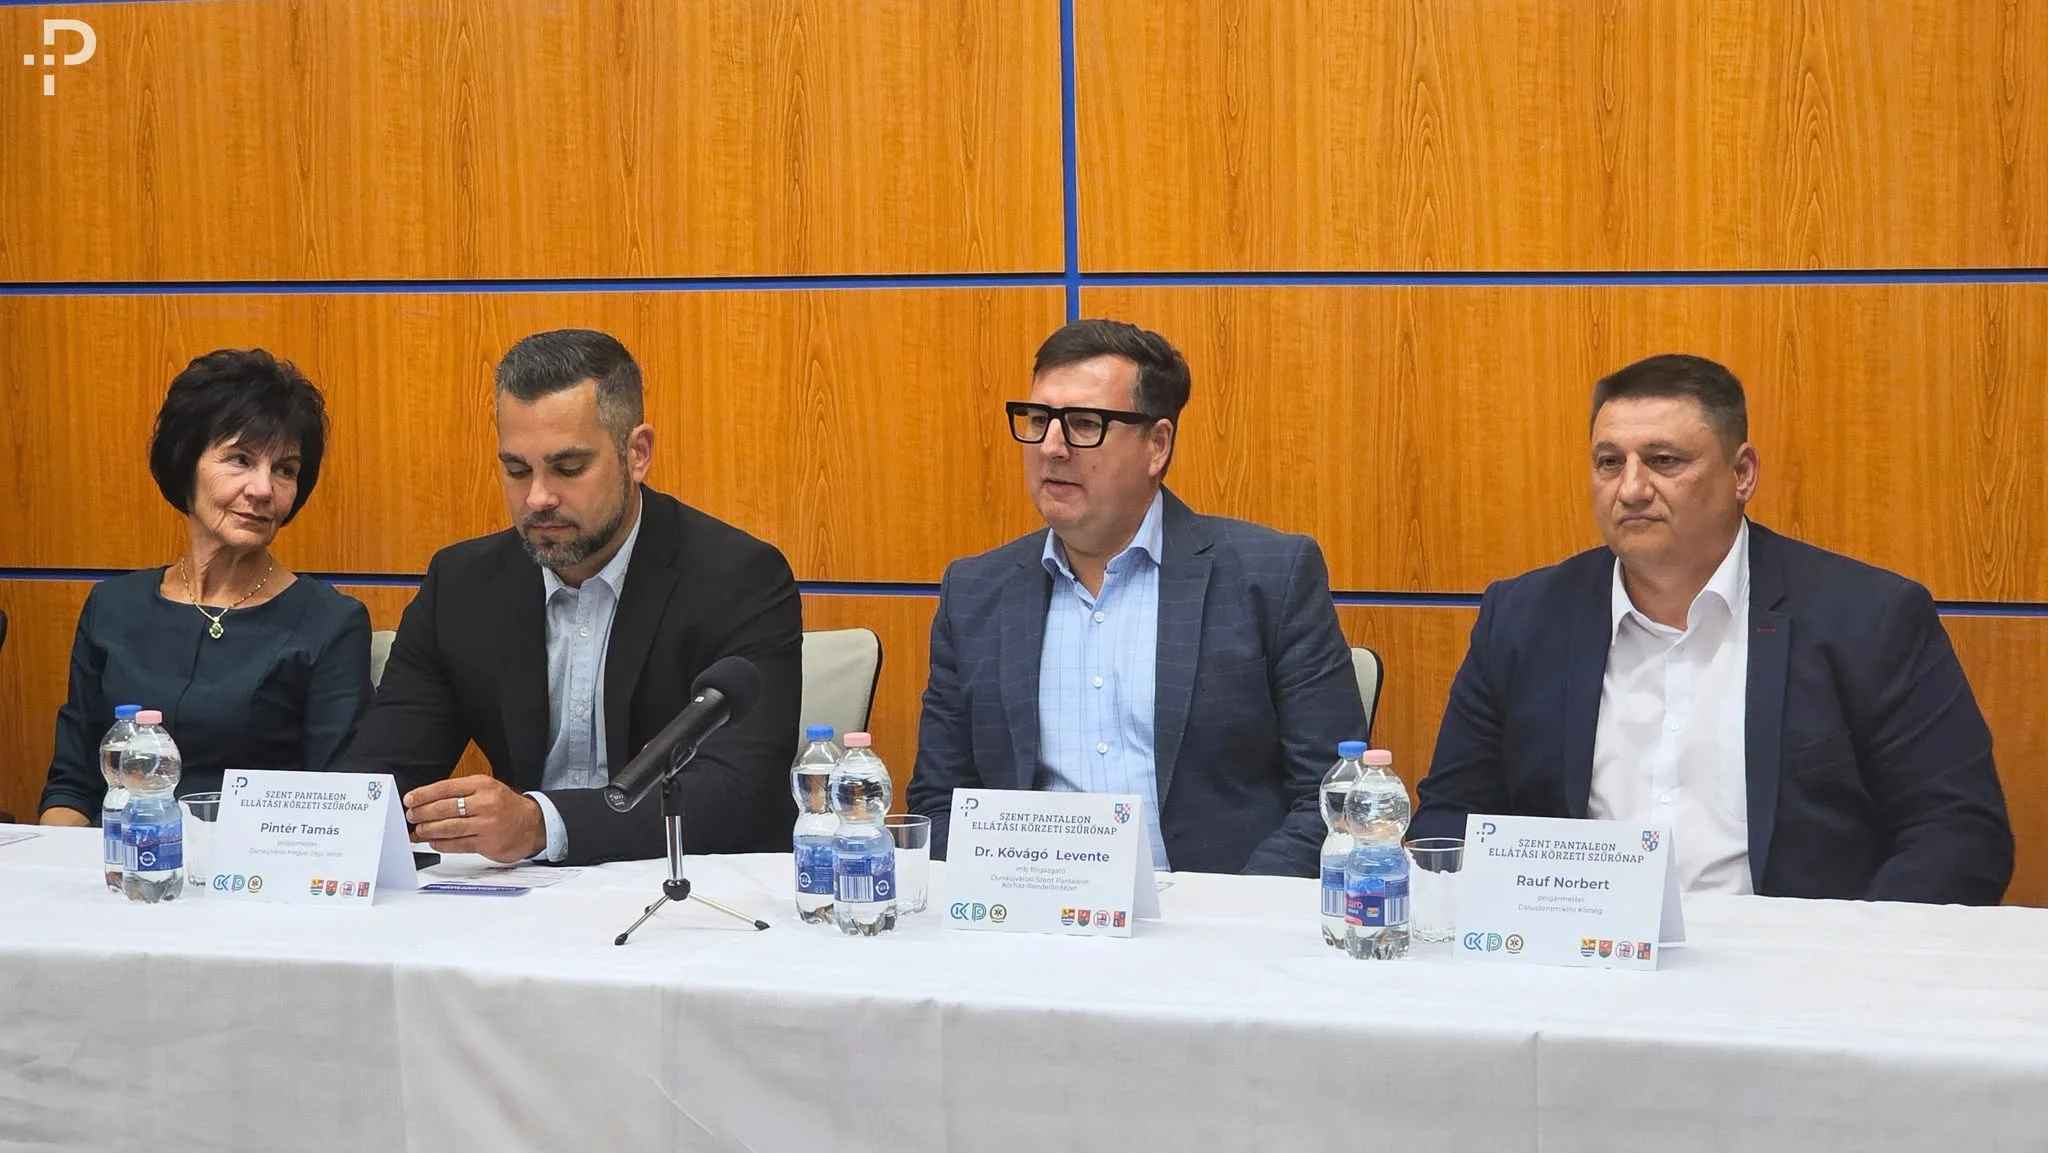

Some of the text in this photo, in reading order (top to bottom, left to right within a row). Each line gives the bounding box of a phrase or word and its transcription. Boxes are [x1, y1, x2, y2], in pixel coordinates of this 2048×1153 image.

[265, 790, 347, 801] SZENT PANTALEON
[240, 798, 369, 812] ELLÁTÁSI KÖRZETI SZŰRŐNAP
[1000, 812, 1091, 824] SZENT PANTALEON
[260, 822, 340, 836] Pintér Tamás
[972, 820, 1118, 836] ELLÁTÁSI KÖRZETI SZŰRŐNAP
[1518, 839, 1616, 852] SZENT PANTALEON
[975, 846, 1110, 862] Dr. Kővágó Levente
[1489, 847, 1645, 864] ELLÁTÁSI KÖRZETI SZŰRŐNAP
[1516, 875, 1610, 890] Rauf Norbert
